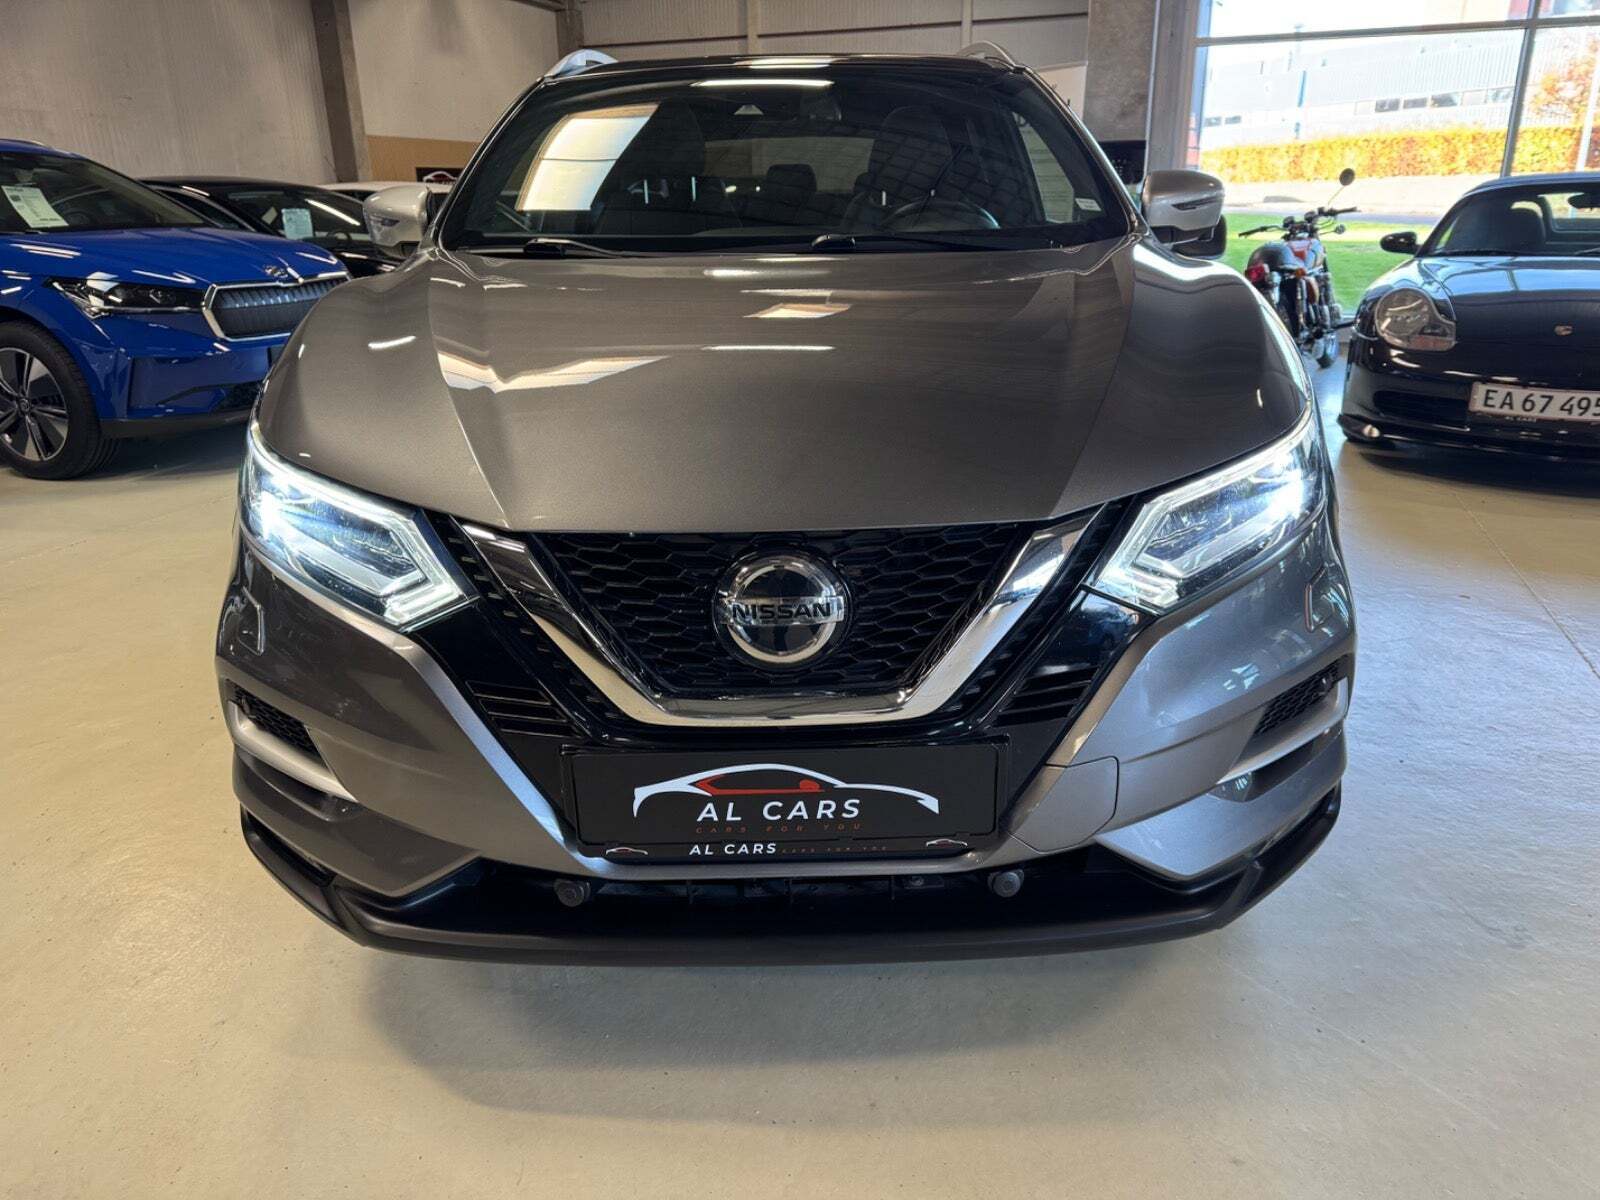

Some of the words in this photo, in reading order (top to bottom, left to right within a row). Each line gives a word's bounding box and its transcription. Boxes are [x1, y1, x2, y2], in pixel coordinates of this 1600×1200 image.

[1483, 389, 1515, 410] EA
[1521, 393, 1554, 414] 67
[732, 602, 831, 620] NISSAN
[696, 802, 742, 822] AL
[762, 799, 860, 821] CARS
[689, 844, 714, 856] AL
[724, 842, 777, 855] CARS
